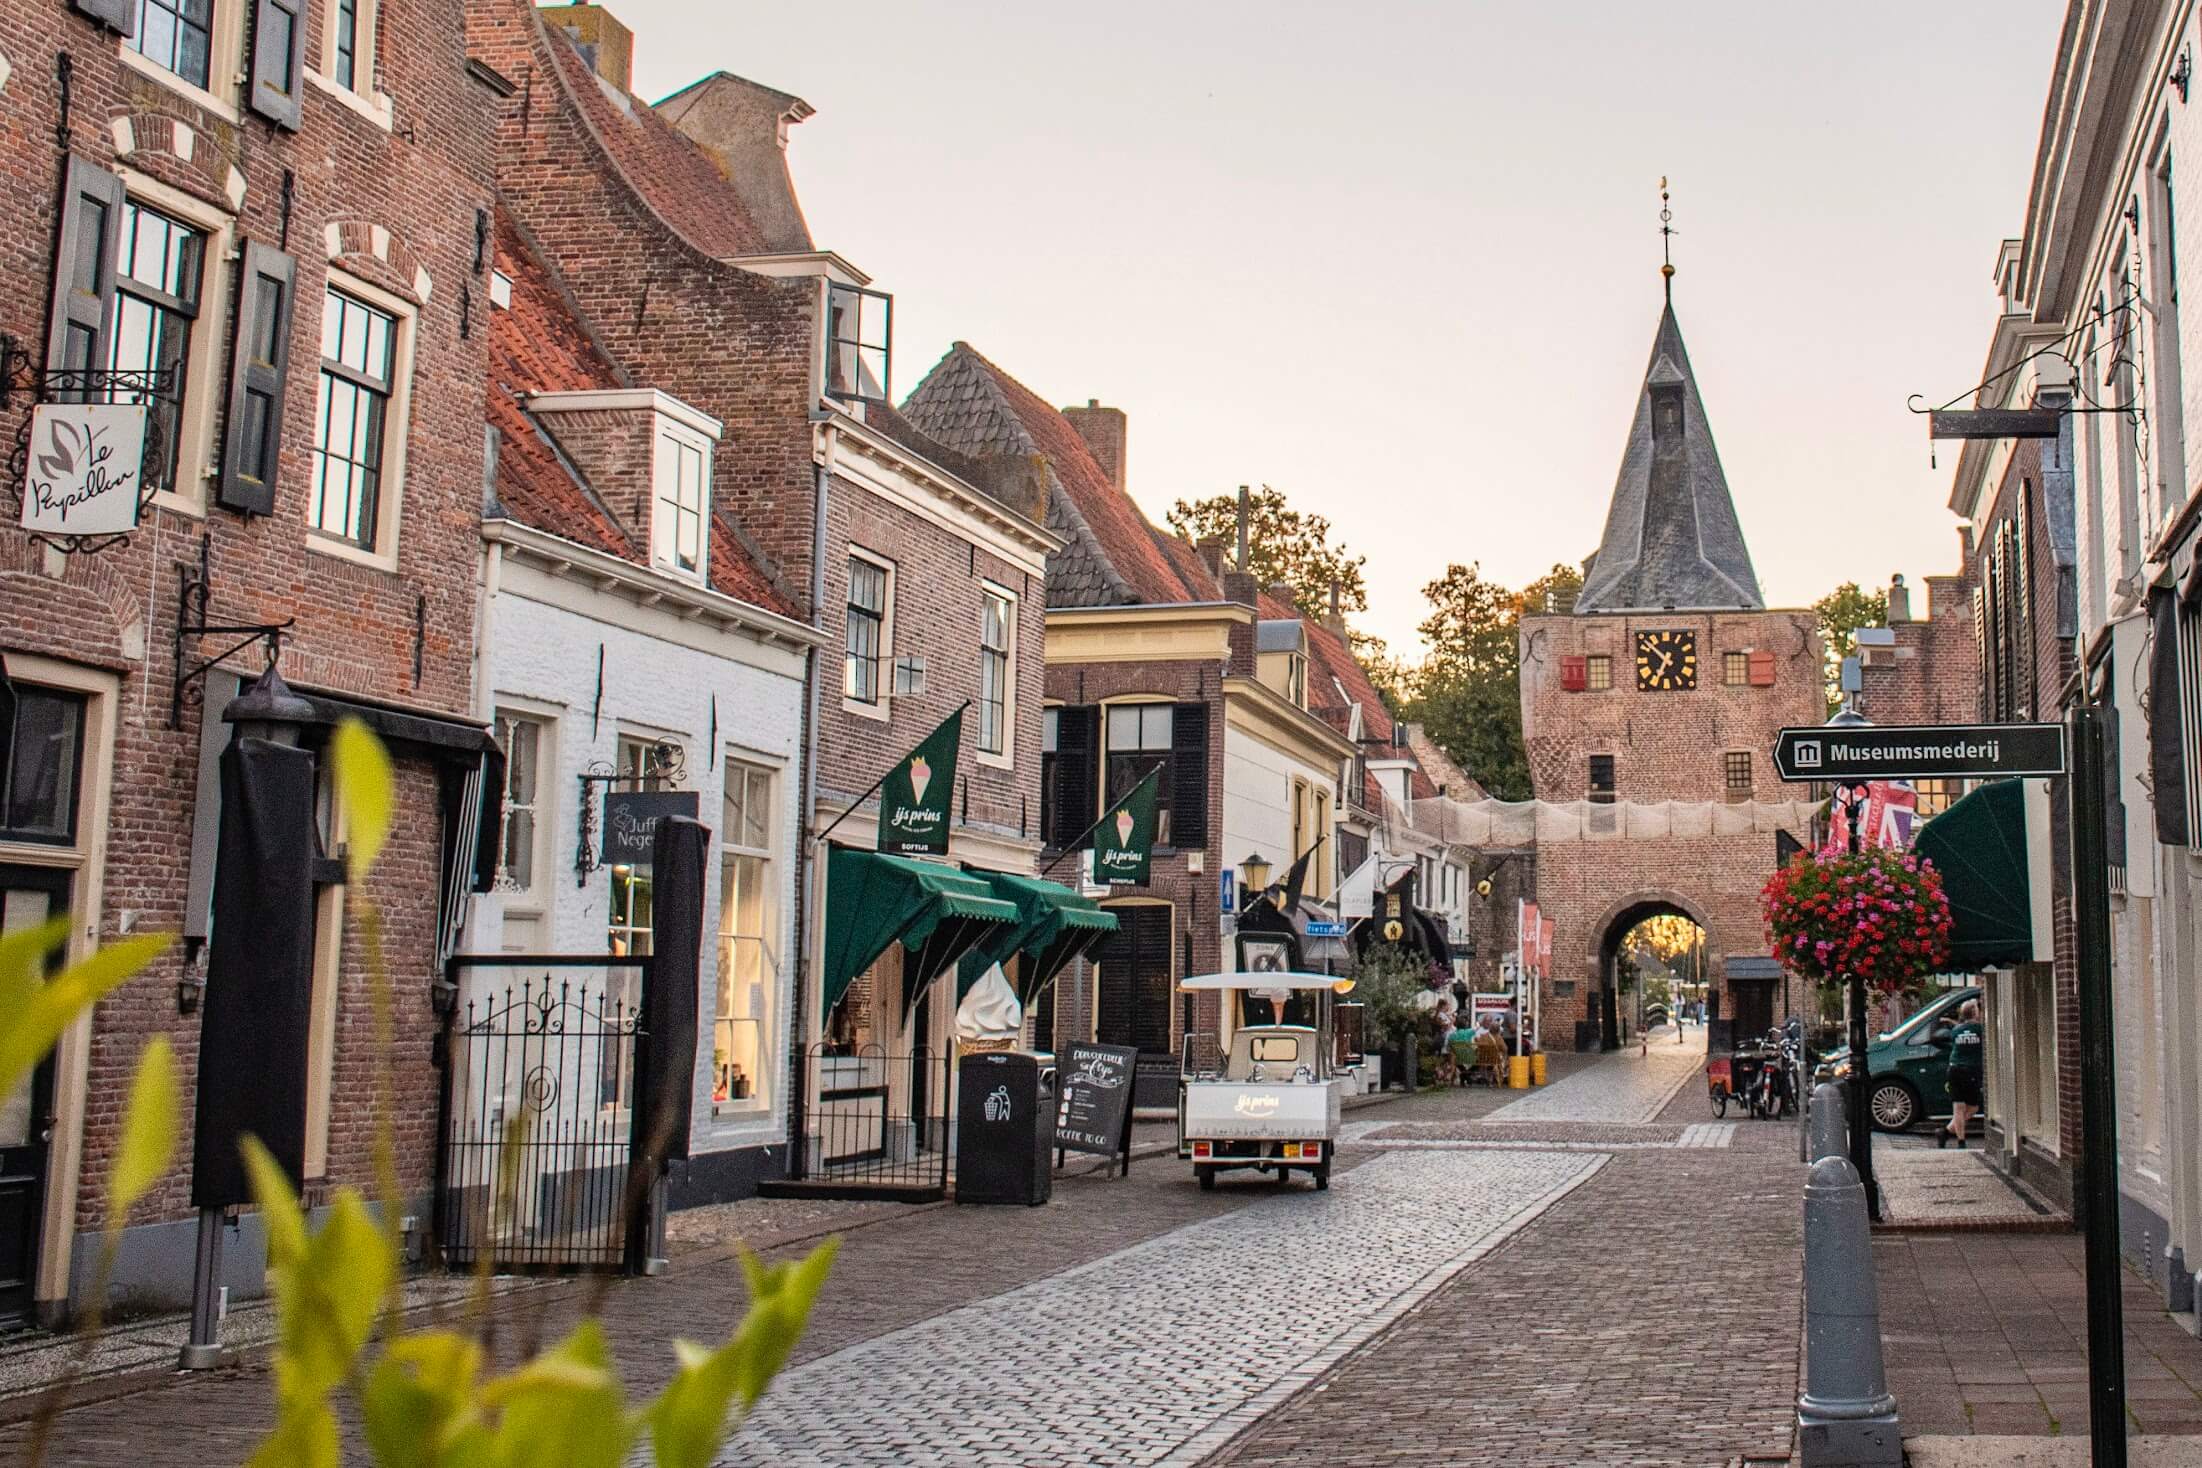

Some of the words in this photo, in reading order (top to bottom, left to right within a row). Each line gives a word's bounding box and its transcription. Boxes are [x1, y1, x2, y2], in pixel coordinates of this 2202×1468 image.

[84, 424, 114, 467] Le
[32, 467, 135, 522] Papillon
[1830, 740, 2000, 763] Museumsmederij
[618, 832, 654, 851] Nege
[901, 843, 929, 851] SOFTIJS
